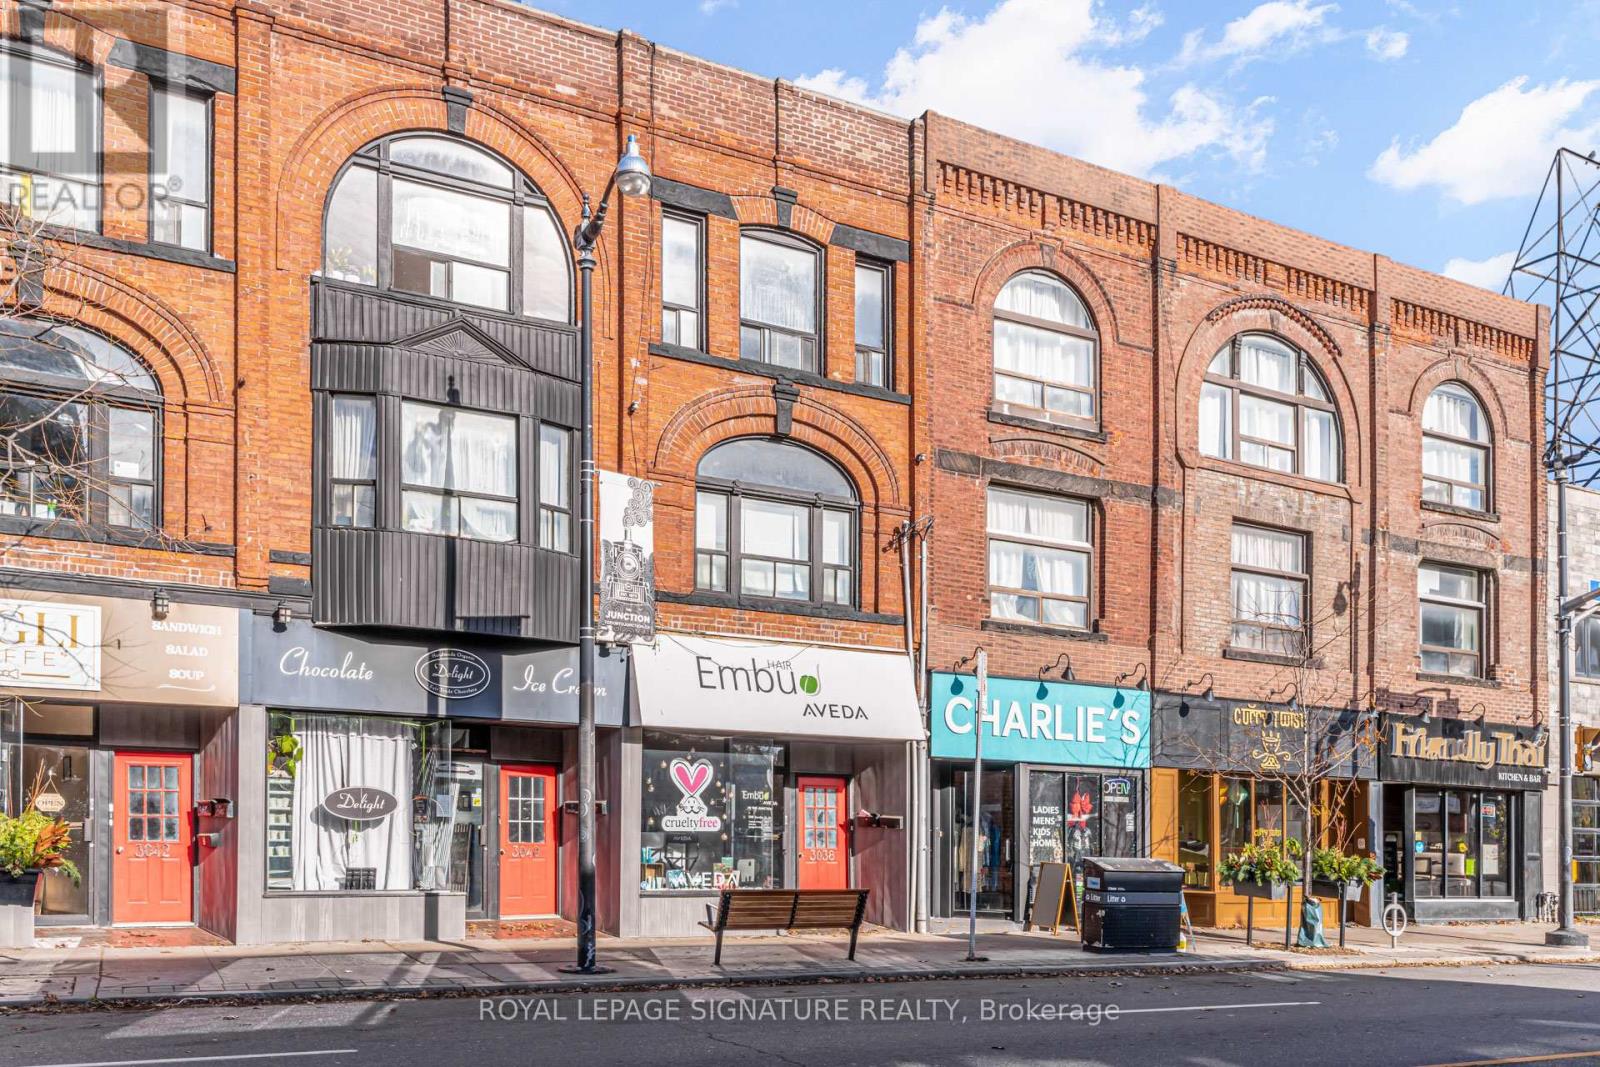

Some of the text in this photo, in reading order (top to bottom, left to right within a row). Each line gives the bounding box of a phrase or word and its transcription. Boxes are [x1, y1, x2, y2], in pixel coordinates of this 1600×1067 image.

[605, 610, 650, 624] JUNCTION
[151, 620, 222, 635] SANDWICH
[165, 644, 209, 656] SALAD
[279, 647, 375, 681] Chocolate
[767, 659, 792, 670] HAIR
[169, 668, 204, 680] SOUP
[432, 662, 474, 682] Delight
[513, 664, 608, 696] Ice Crem
[803, 703, 869, 720] AVEDA
[944, 696, 1142, 746] CHARLIE'S
[1491, 731, 1547, 768] Thai
[1498, 772, 1541, 783] KITCHEN & BAR
[1103, 782, 1129, 795] OPEN
[37, 799, 64, 808] OPEN
[336, 791, 386, 812] Delight
[1032, 806, 1060, 815] LADIES
[664, 816, 719, 830] crueltyfree
[1032, 817, 1056, 825] MENS
[1032, 828, 1051, 836] KIDS
[1032, 839, 1057, 847] HOME
[670, 871, 741, 887] AVEDA
[1107, 895, 1120, 903] Litter
